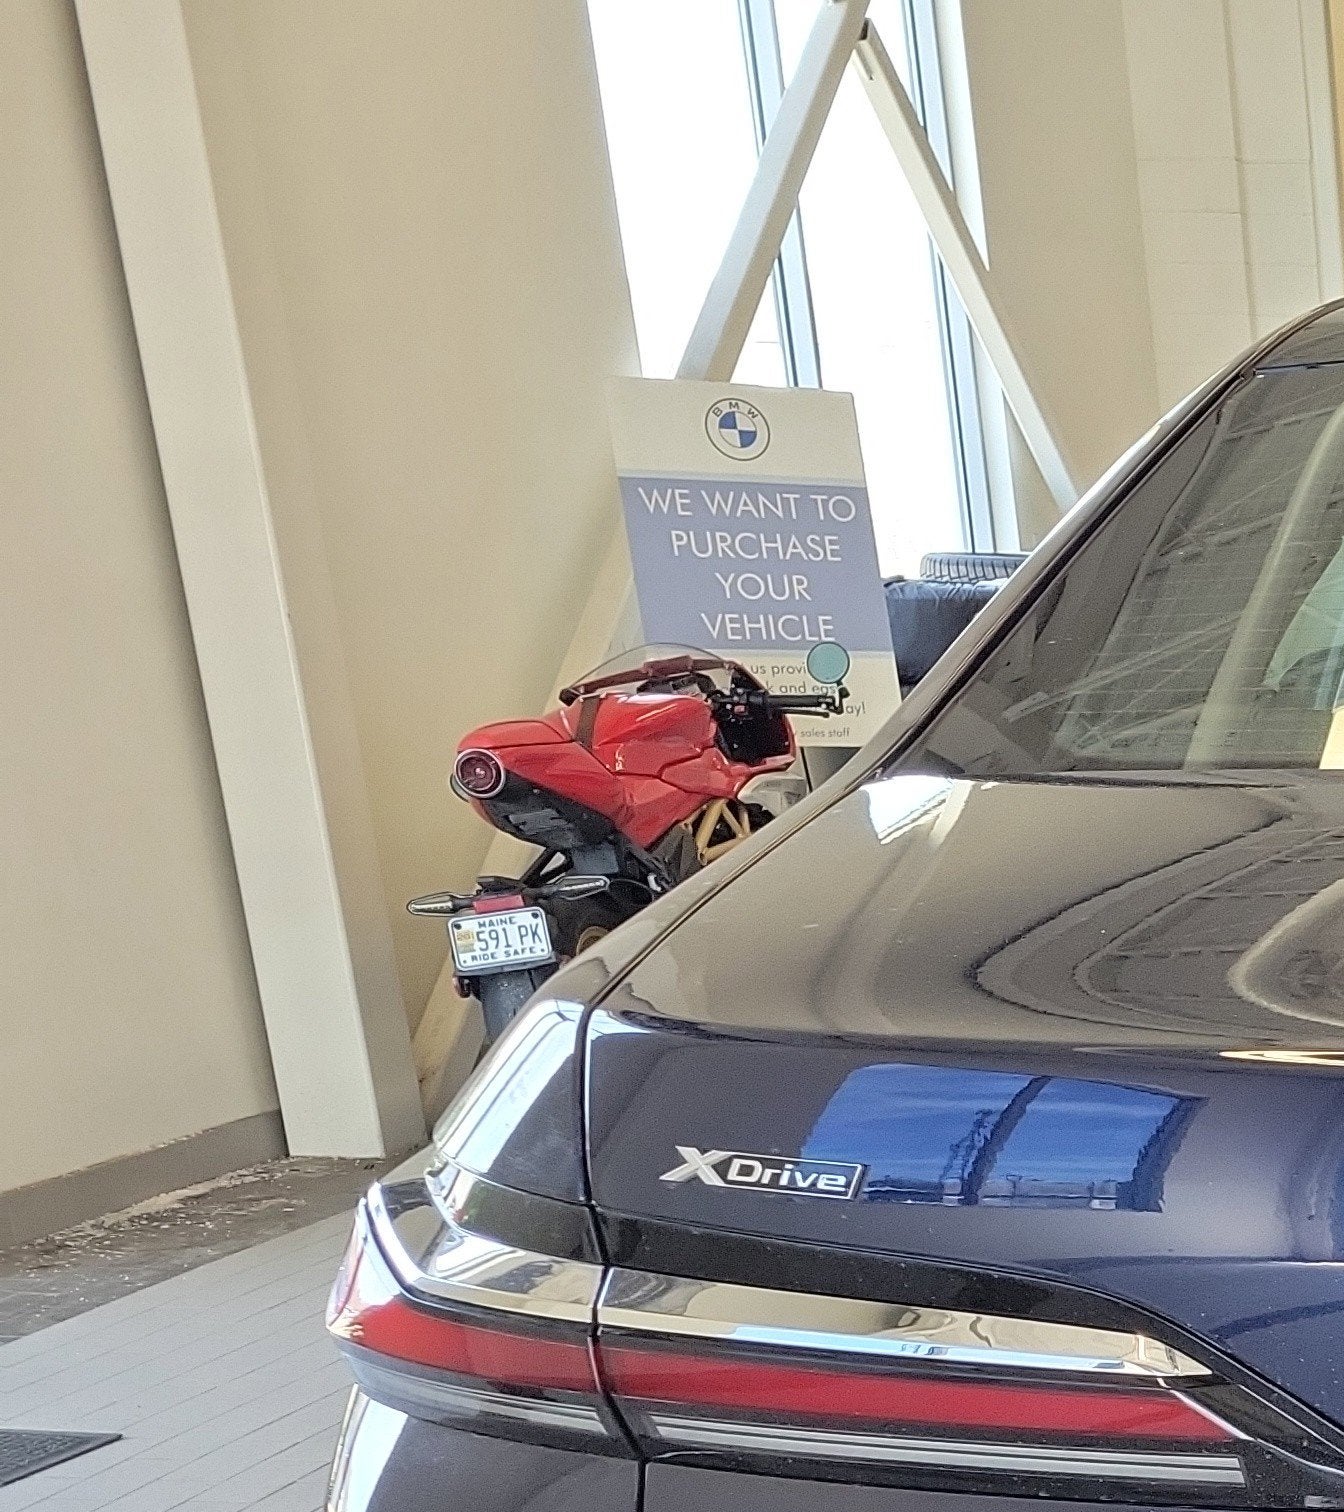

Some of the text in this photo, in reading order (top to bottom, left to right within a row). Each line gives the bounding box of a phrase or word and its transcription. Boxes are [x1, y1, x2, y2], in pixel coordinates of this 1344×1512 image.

[712, 402, 759, 419] BMW
[638, 486, 856, 522] WE WANT TO
[671, 530, 842, 562] PURCHASE
[715, 572, 812, 601] YOUR
[700, 613, 836, 641] VEHICLE
[750, 661, 807, 677] us provi
[780, 681, 806, 694] and
[812, 685, 837, 694] eas
[801, 726, 850, 738] sales staff
[478, 916, 517, 928] MAINE
[476, 927, 512, 951] 591
[518, 923, 543, 945] PK
[471, 946, 537, 962] RIDE SAFE
